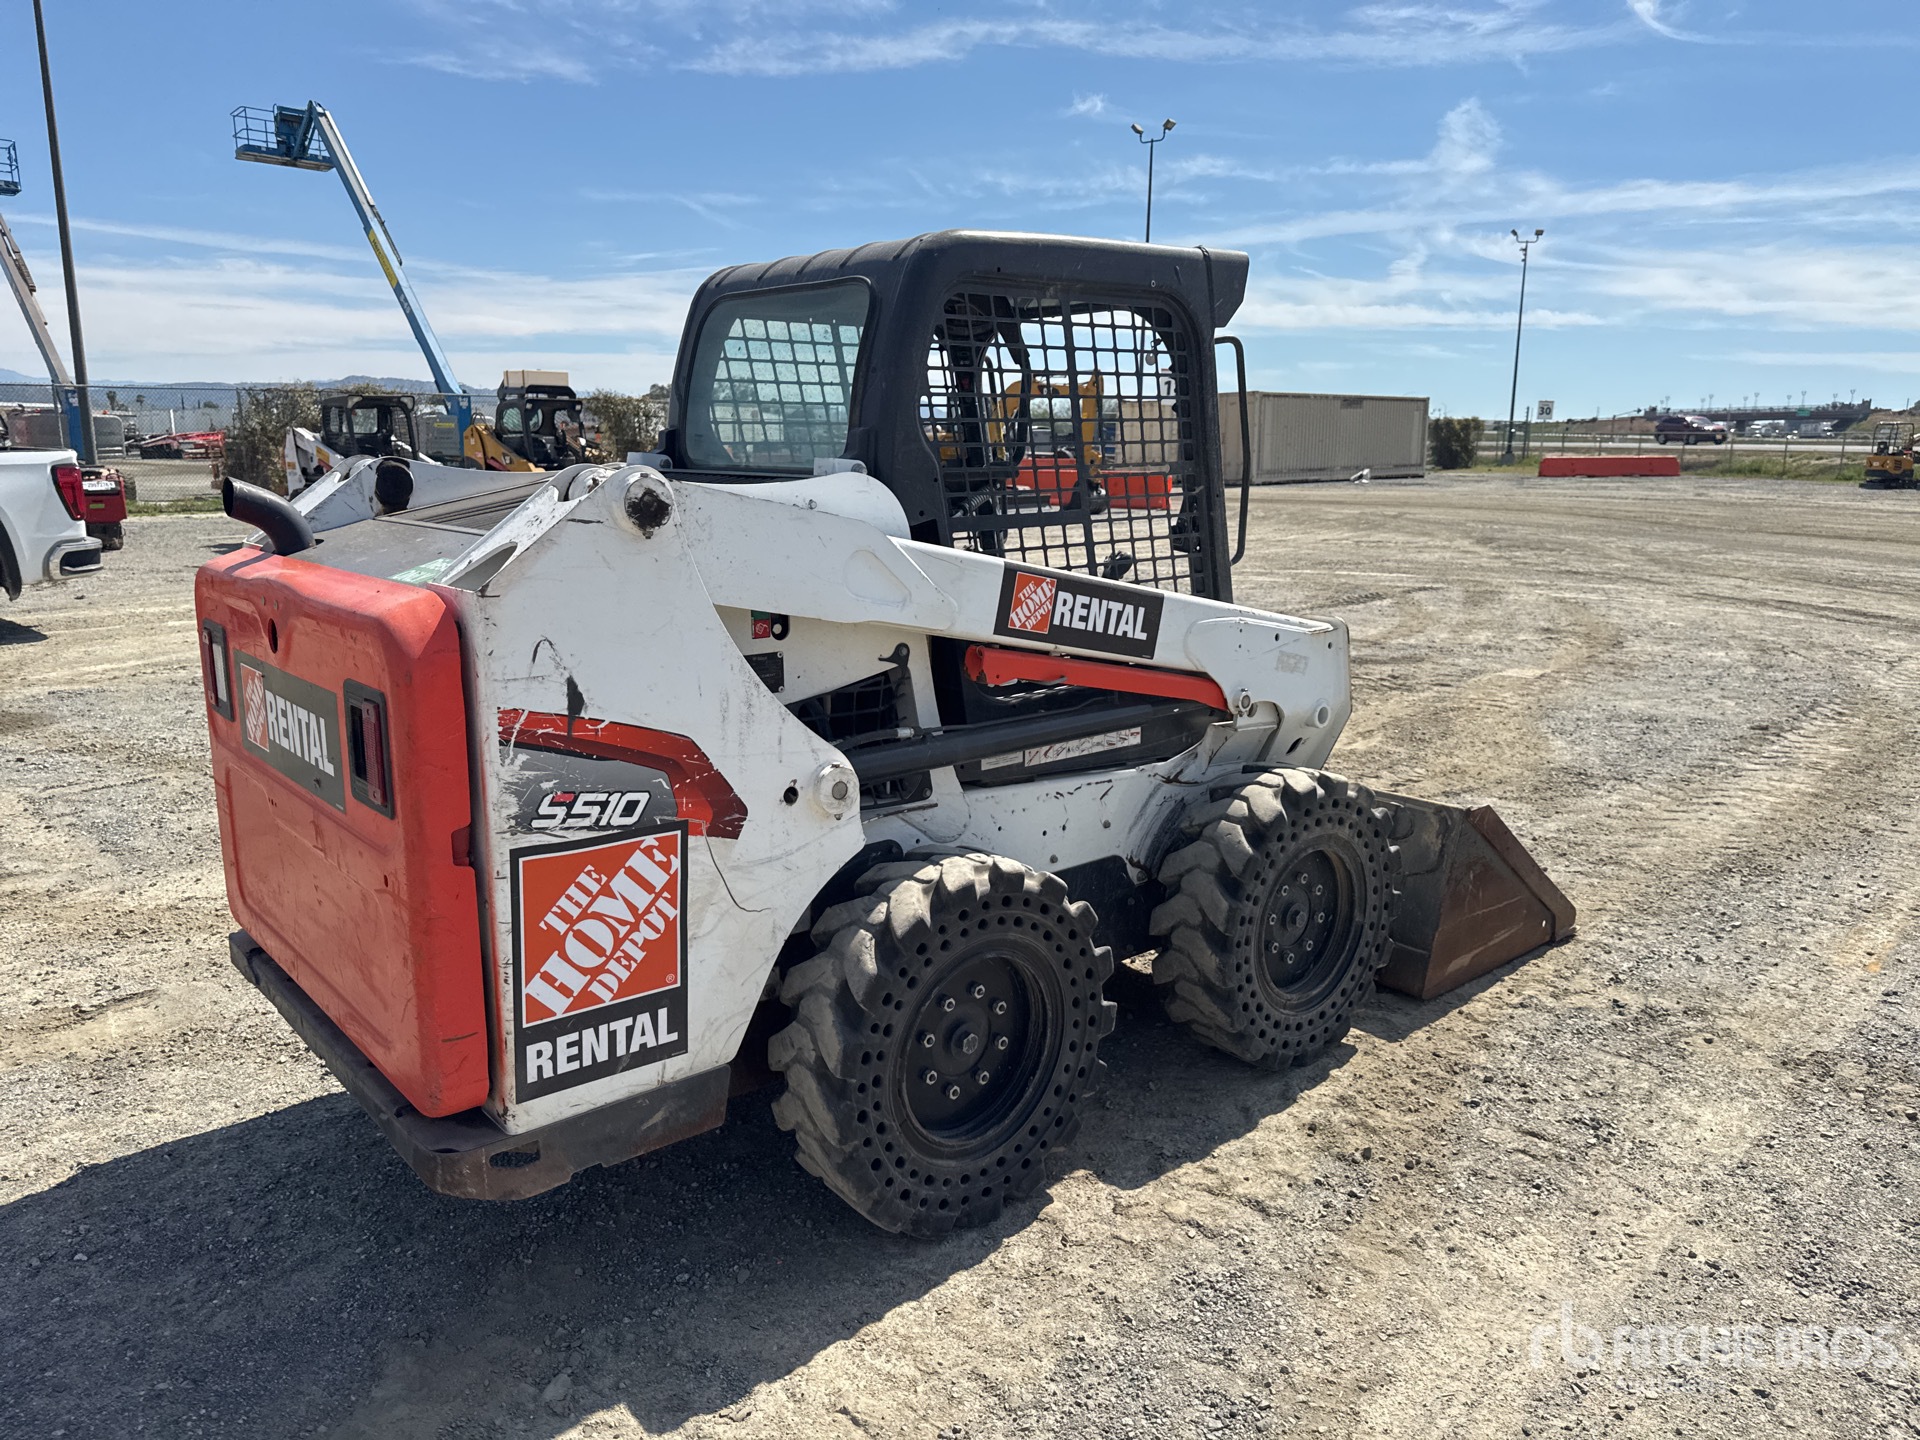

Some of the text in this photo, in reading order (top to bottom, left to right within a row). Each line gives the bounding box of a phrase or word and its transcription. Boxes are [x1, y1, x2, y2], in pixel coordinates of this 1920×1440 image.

[1539, 406, 1552, 415] 30
[1010, 578, 1055, 628] HOME
[1017, 580, 1037, 602] THE
[1025, 600, 1052, 630] DEPOT
[1052, 590, 1147, 641] RENTAL
[265, 689, 335, 777] RENTAL
[531, 791, 651, 828] S510
[538, 864, 608, 935] THE
[525, 836, 679, 1015] HOME
[587, 891, 678, 1003] DEPOT
[526, 1006, 678, 1084] RENTAL
